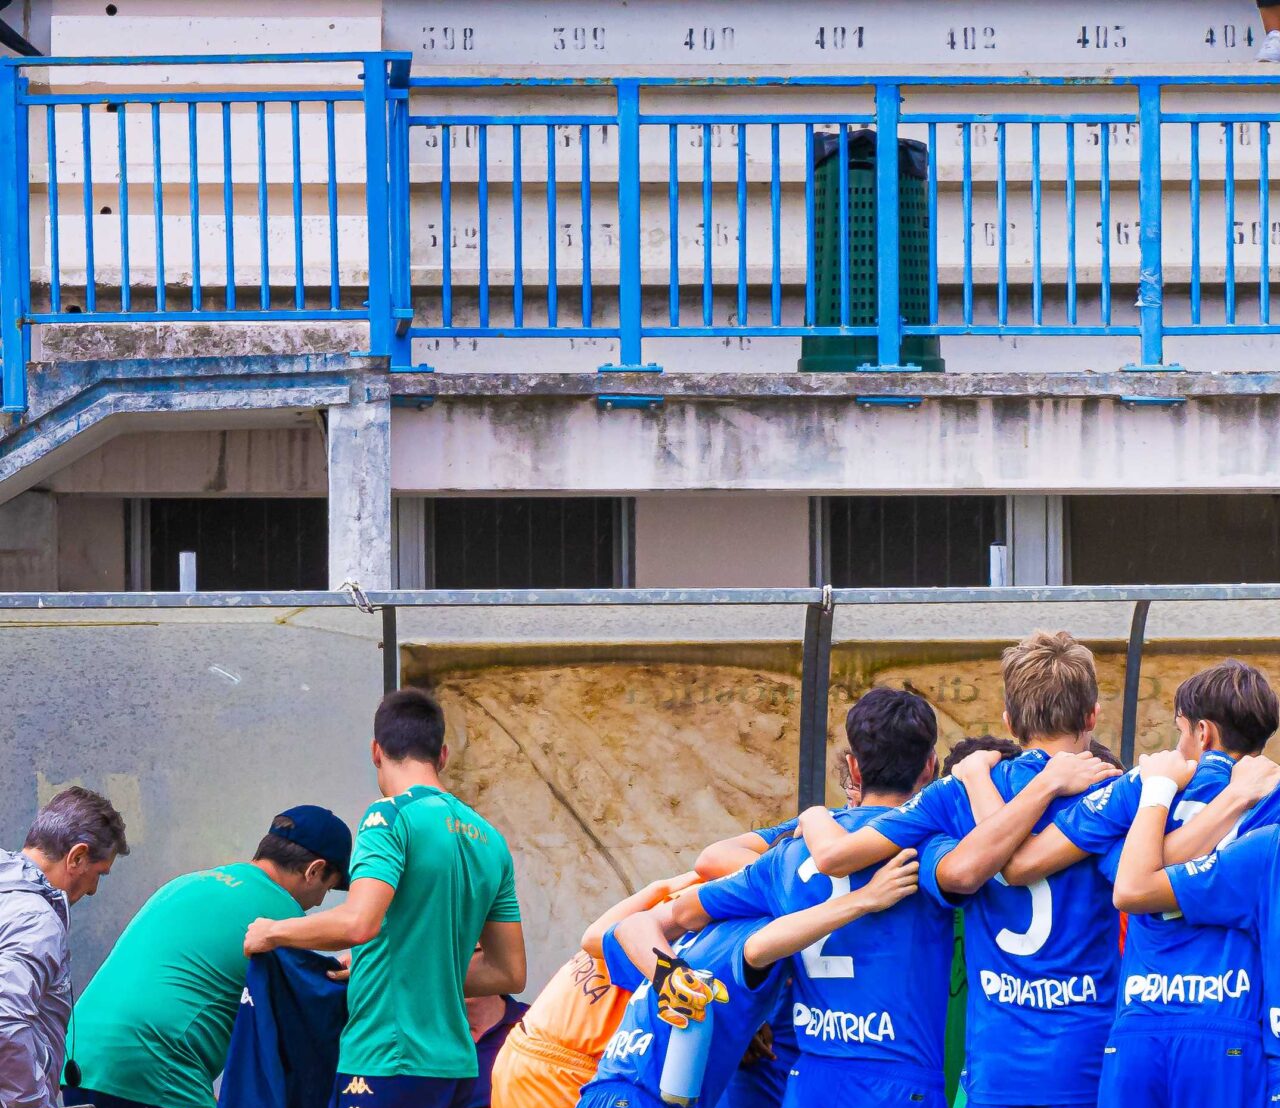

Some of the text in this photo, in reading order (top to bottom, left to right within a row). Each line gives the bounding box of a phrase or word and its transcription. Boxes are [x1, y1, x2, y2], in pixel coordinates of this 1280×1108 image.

[422, 26, 474, 50] 398
[552, 26, 606, 50] 399
[683, 26, 735, 50] 400
[814, 26, 865, 50] 401
[946, 26, 996, 50] 402
[1204, 24, 1254, 48] 404
[797, 856, 855, 979] 2
[979, 969, 1098, 1010] PEDIATRICA
[1124, 968, 1251, 1007] PEDIATRICA
